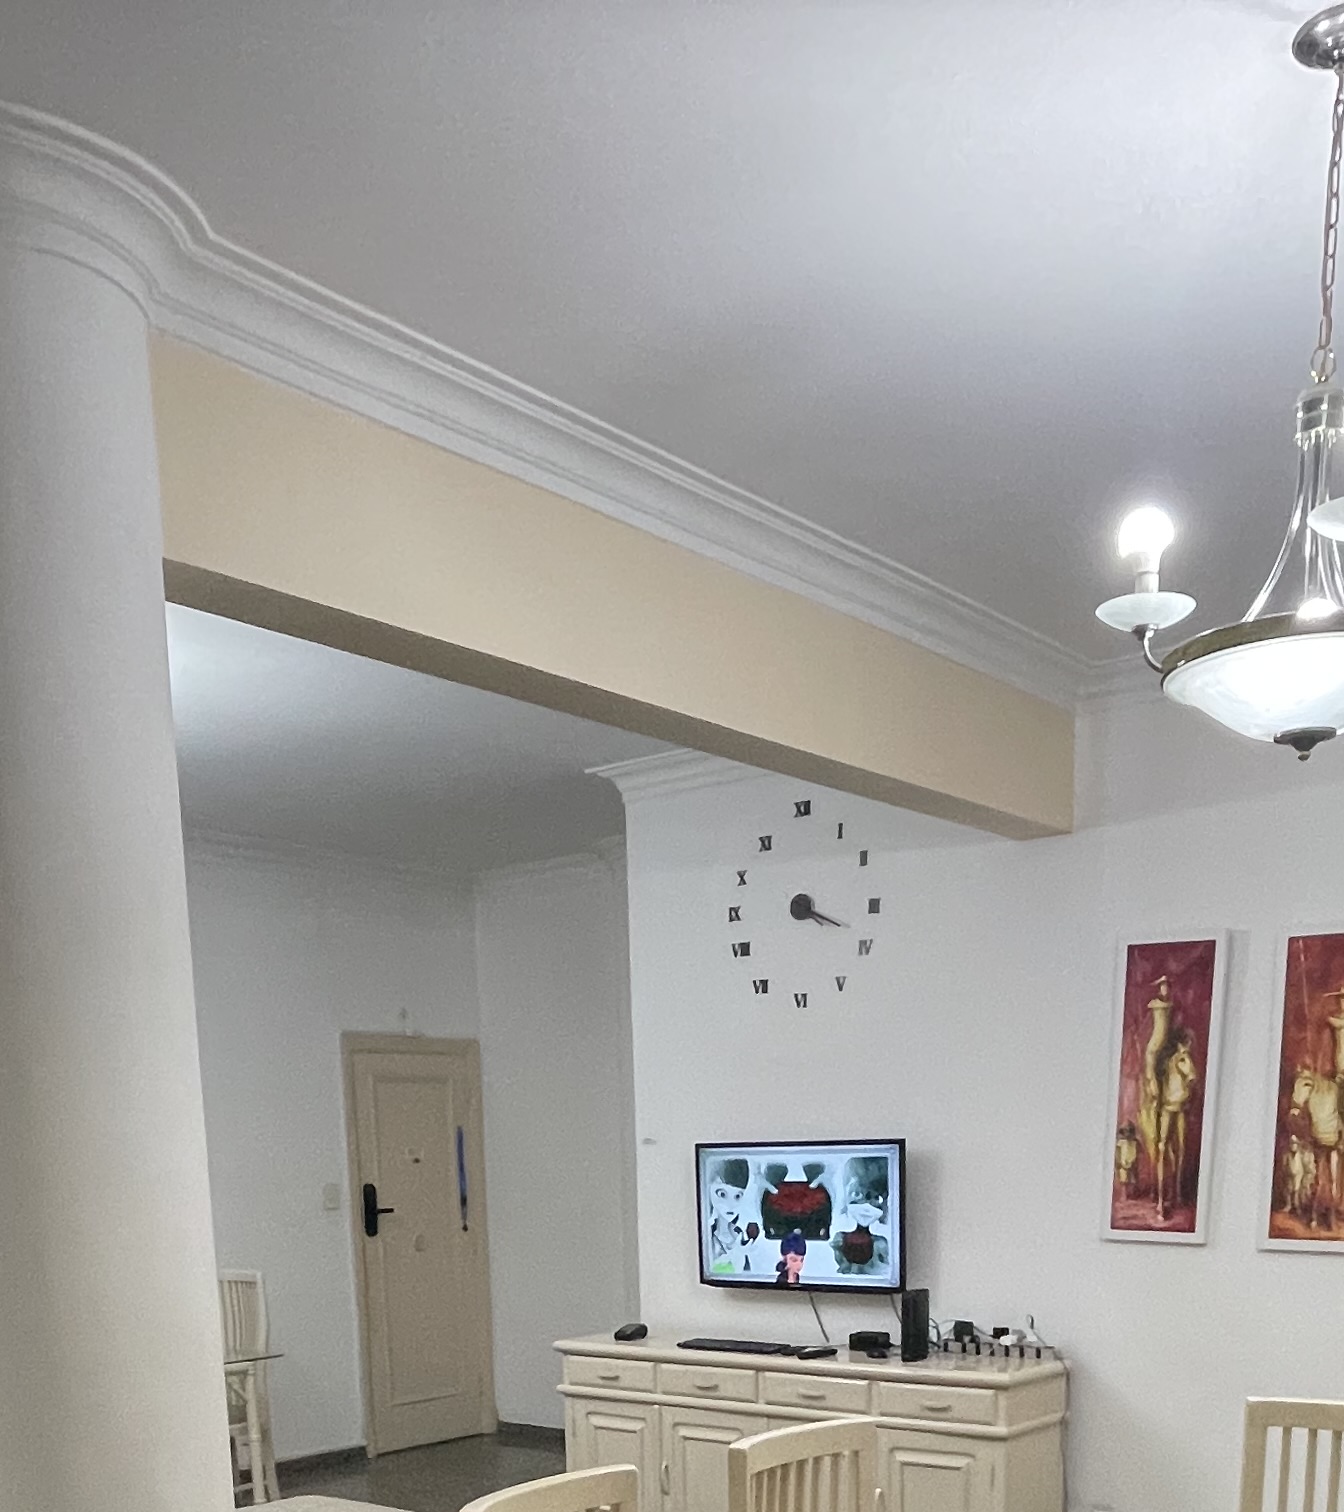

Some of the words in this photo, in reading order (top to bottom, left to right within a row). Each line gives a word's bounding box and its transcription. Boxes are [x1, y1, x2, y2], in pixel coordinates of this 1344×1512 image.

[758, 835, 773, 853] XI
[736, 870, 748, 887] X
[728, 905, 742, 923] IX
[858, 938, 874, 957] IV
[835, 976, 847, 992] V
[794, 993, 808, 1009] VI
